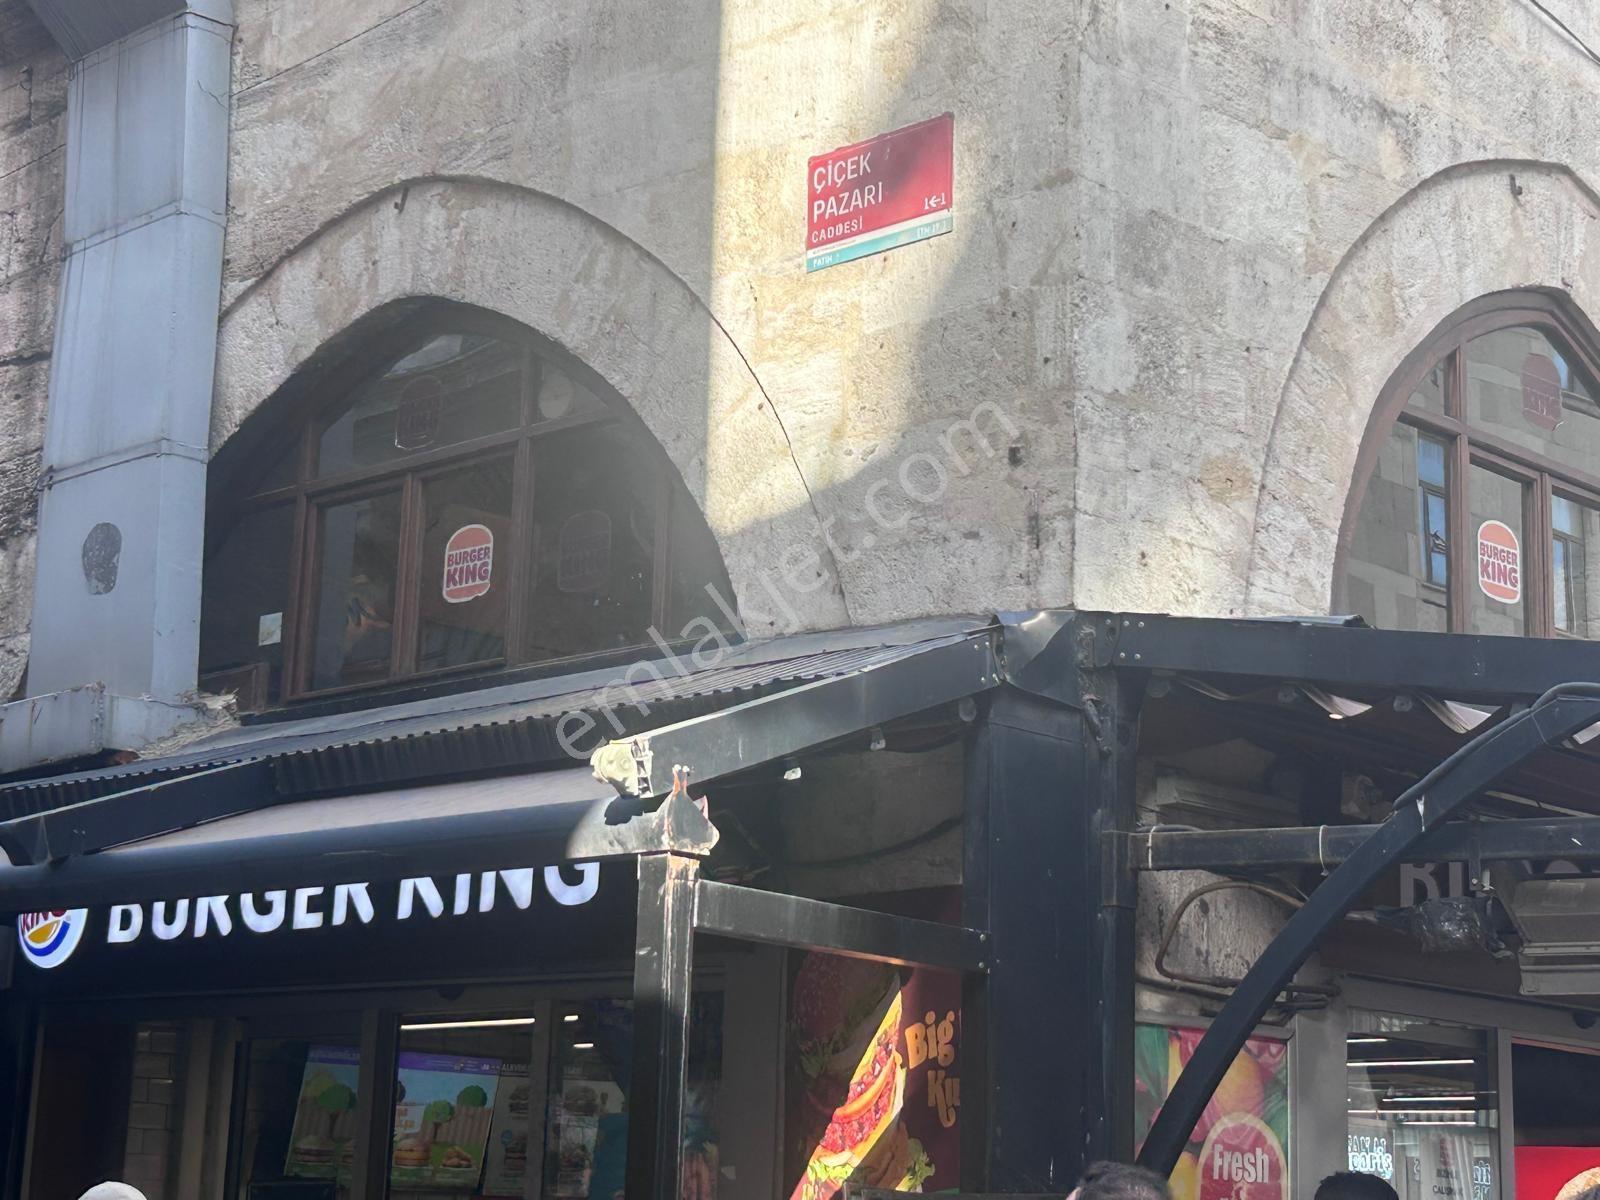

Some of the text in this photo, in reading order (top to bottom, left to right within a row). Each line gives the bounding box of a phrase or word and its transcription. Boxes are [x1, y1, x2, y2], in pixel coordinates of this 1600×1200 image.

[813, 151, 872, 194] ÇİÇEK
[813, 181, 883, 224] PAZARI
[447, 546, 491, 568] BURGER
[1479, 541, 1518, 568] BURGER
[1479, 556, 1519, 589] KING
[446, 561, 490, 589] KING
[904, 1010, 955, 1069] Big
[1212, 1143, 1270, 1185] Fresh
